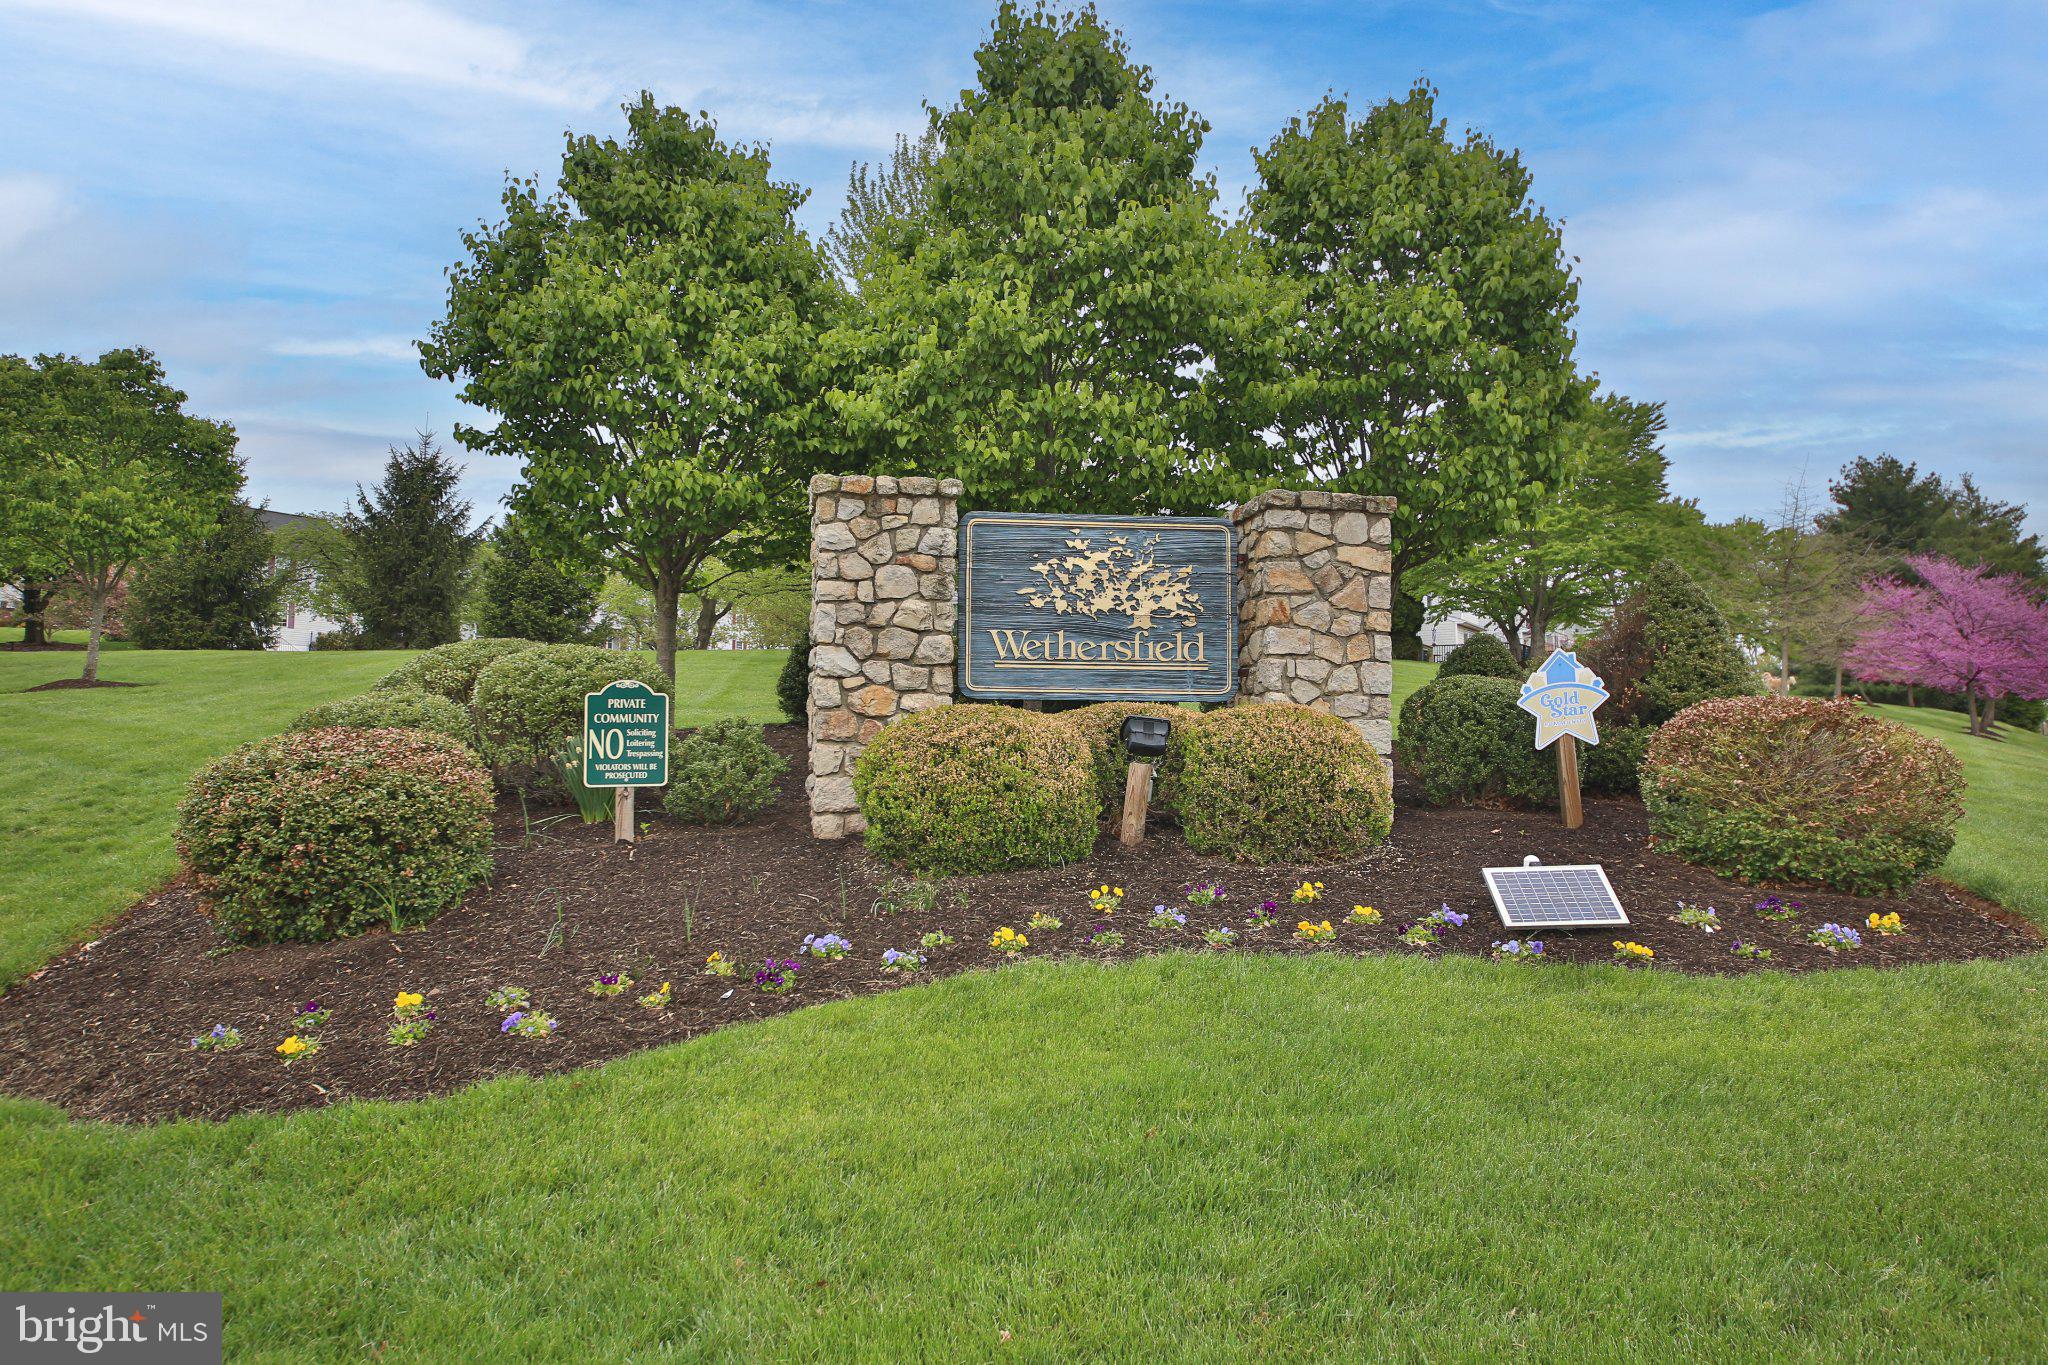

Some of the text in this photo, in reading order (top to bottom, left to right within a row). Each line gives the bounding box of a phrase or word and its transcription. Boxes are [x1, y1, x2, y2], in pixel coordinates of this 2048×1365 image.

[986, 629, 1208, 662] Wethersfield
[607, 698, 646, 709] PRIVATE
[1540, 690, 1580, 708] Gold
[1551, 704, 1588, 718] Star
[593, 713, 660, 724] COMMUNITY
[626, 728, 657, 738] Soliciting
[588, 728, 624, 760] NO
[626, 739, 656, 749] Loitering
[626, 749, 664, 759] Trespassing
